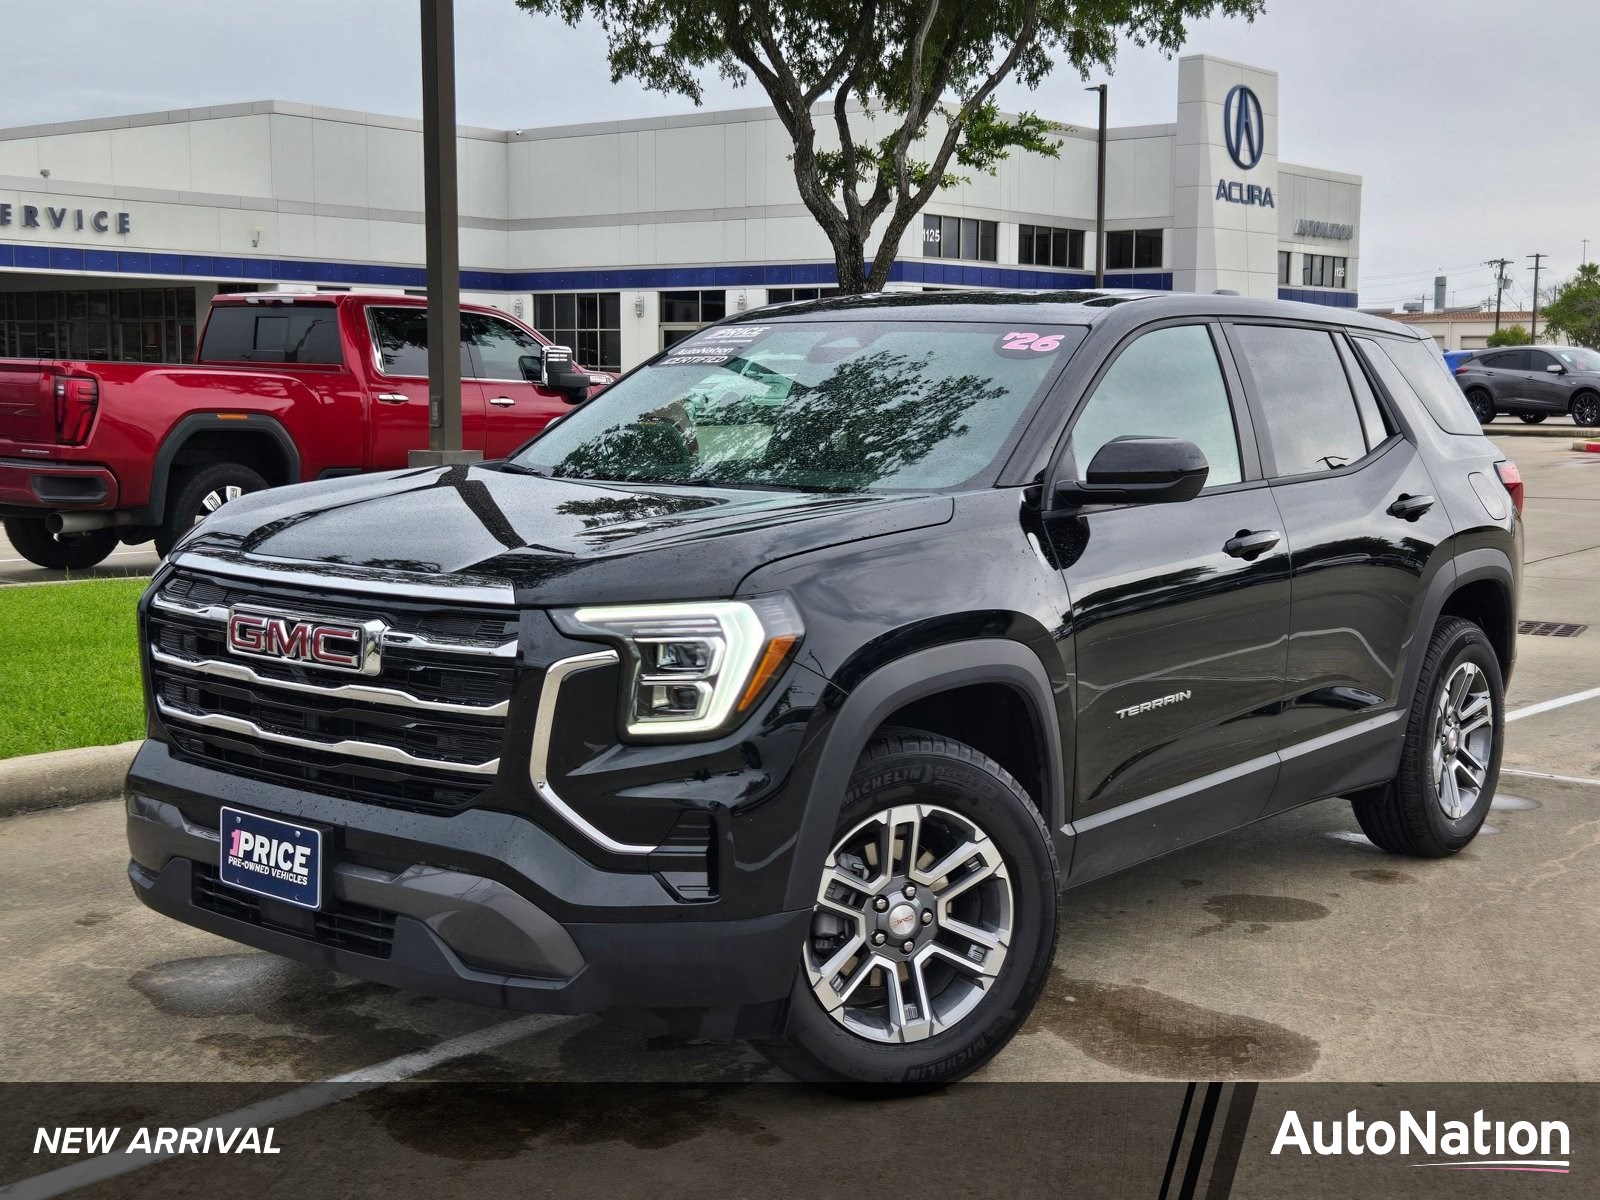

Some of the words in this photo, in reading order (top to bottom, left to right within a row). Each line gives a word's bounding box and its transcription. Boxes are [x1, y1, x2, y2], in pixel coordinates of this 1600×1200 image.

[1216, 178, 1274, 209] ACURA
[229, 613, 360, 667] GMC
[1115, 690, 1192, 719] TERRAIN
[229, 828, 311, 876] 1PRICE
[228, 856, 270, 875] PRE-OWNED
[271, 868, 308, 886] VEHICLES
